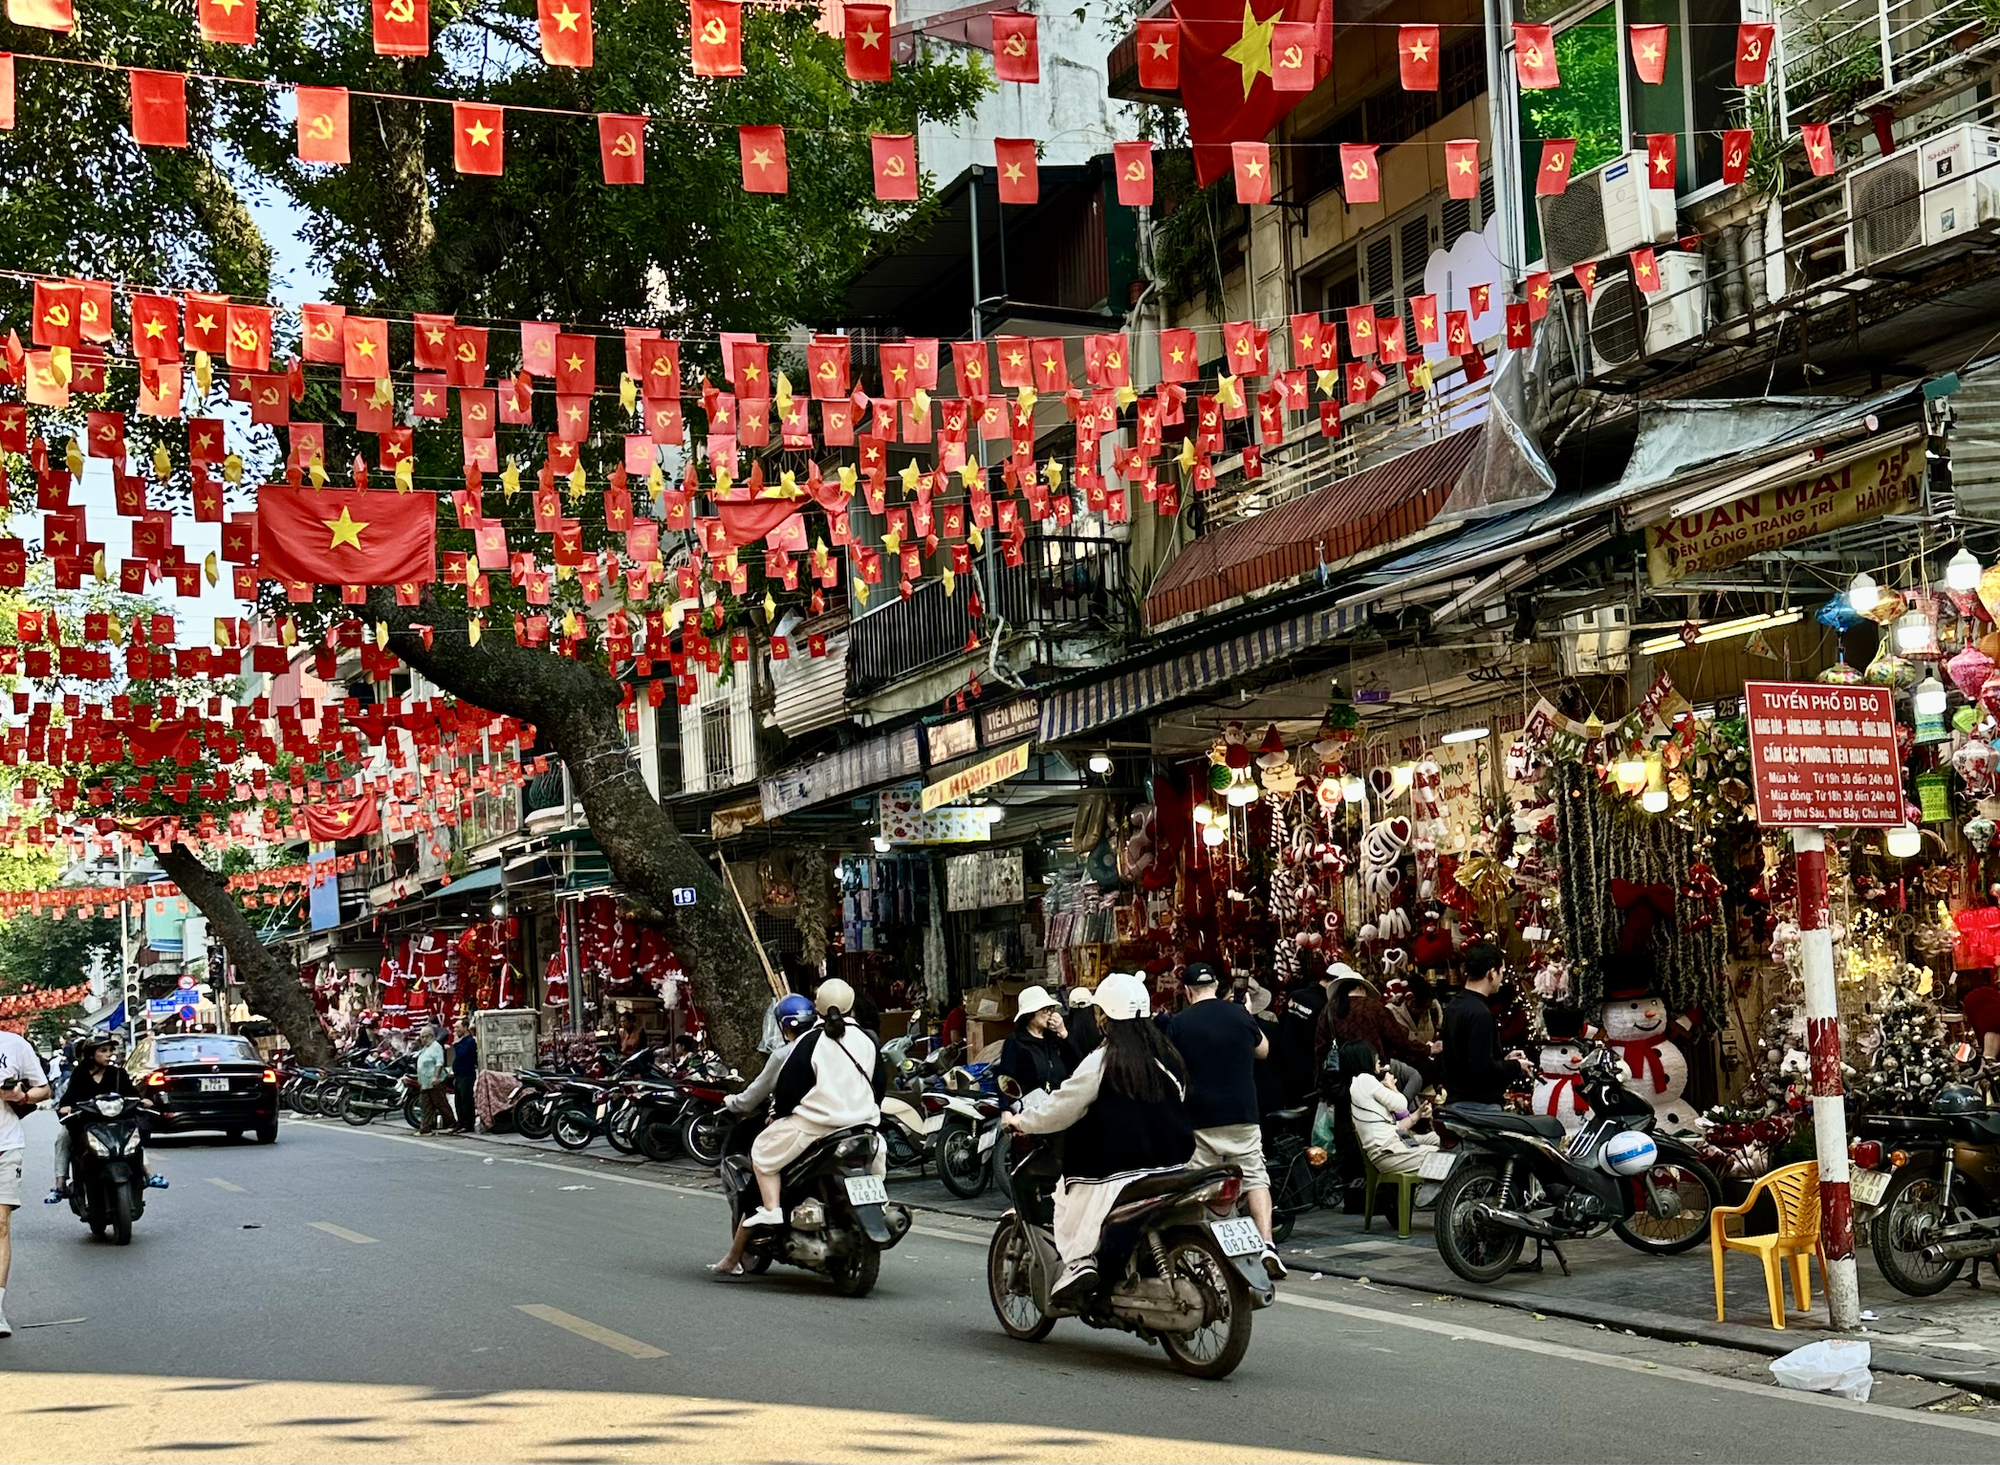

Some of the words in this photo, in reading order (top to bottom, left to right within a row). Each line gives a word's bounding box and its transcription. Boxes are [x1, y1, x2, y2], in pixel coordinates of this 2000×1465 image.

[1927, 142, 1960, 161] SHARP
[1775, 465, 1852, 511] MAI
[1856, 484, 1899, 514] HÀNG
[1752, 510, 1806, 535] TRANG
[1810, 496, 1834, 517] TRÍ
[1762, 689, 1809, 710] TUYẾN
[1812, 691, 1841, 711] PHỐ
[1843, 697, 1857, 711] ĐI
[1860, 694, 1879, 716] BỘ
[1763, 742, 1782, 763] CẤM
[1769, 772, 1787, 783] Mùa
[1813, 772, 1824, 784] Từ
[1825, 774, 1839, 784] 19h
[1842, 774, 1851, 784] 30
[1852, 772, 1867, 785] đến
[1869, 774, 1883, 785] 24h
[1884, 774, 1894, 785] 00
[929, 785, 944, 806] 21
[1771, 790, 1788, 801] Mùa
[1815, 789, 1826, 801] Từ
[1828, 791, 1842, 801] 18h
[1843, 791, 1853, 801] 30
[1855, 789, 1869, 802] đến
[1871, 791, 1885, 802] 24h
[1886, 791, 1896, 802] 00
[675, 890, 692, 903] 19
